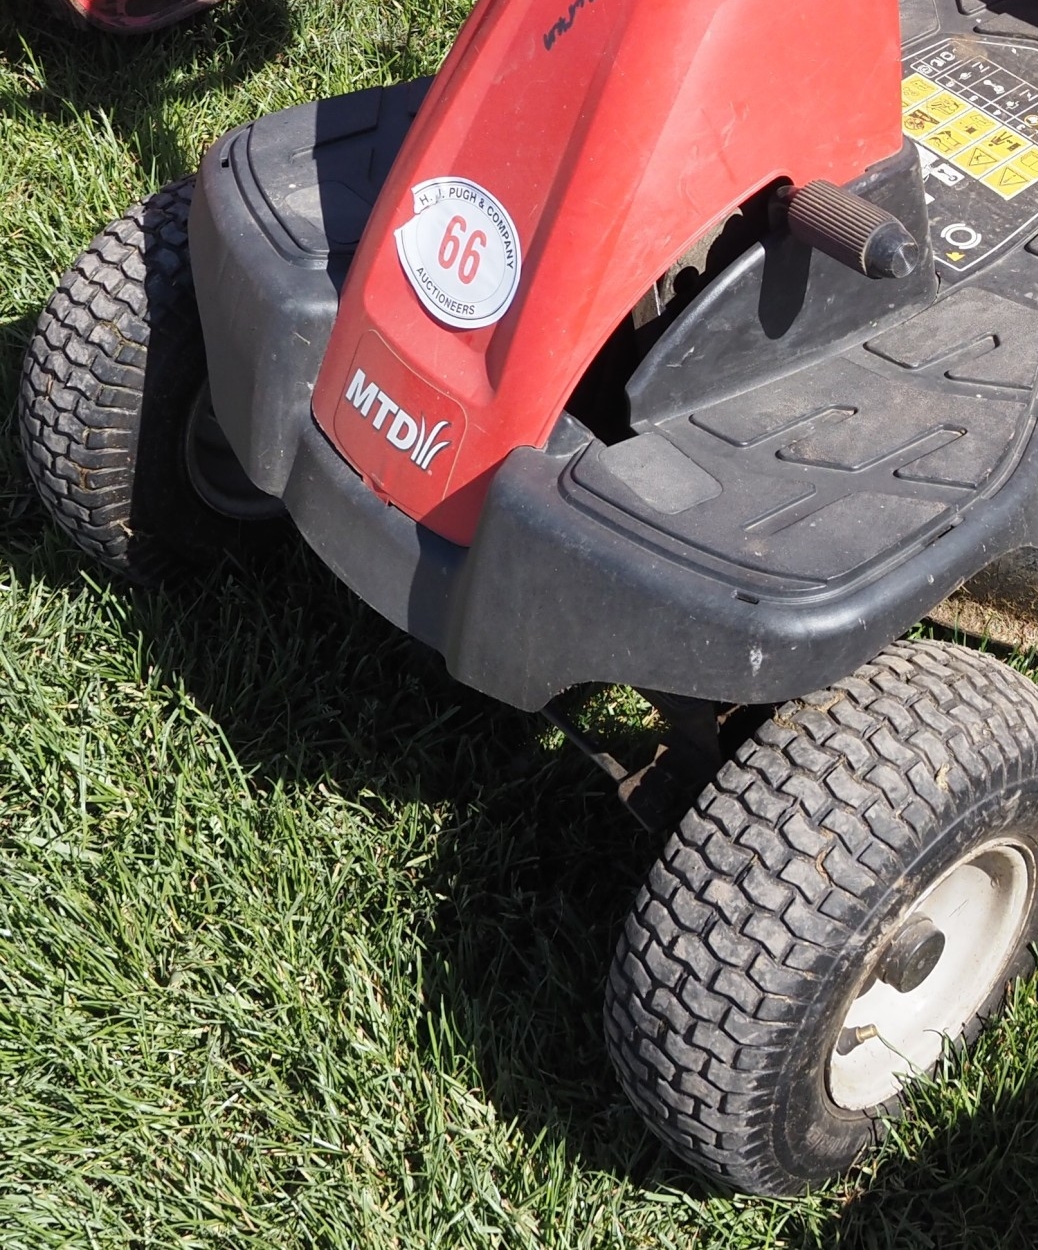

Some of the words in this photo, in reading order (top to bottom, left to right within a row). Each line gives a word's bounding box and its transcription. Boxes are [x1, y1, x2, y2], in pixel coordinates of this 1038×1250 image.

[438, 215, 487, 284] 66
[448, 187, 477, 203] PUGH
[478, 198, 485, 209] &
[487, 205, 514, 269] COMPANY
[416, 267, 475, 315] AUCTIONEERS
[345, 368, 419, 450] MTD
